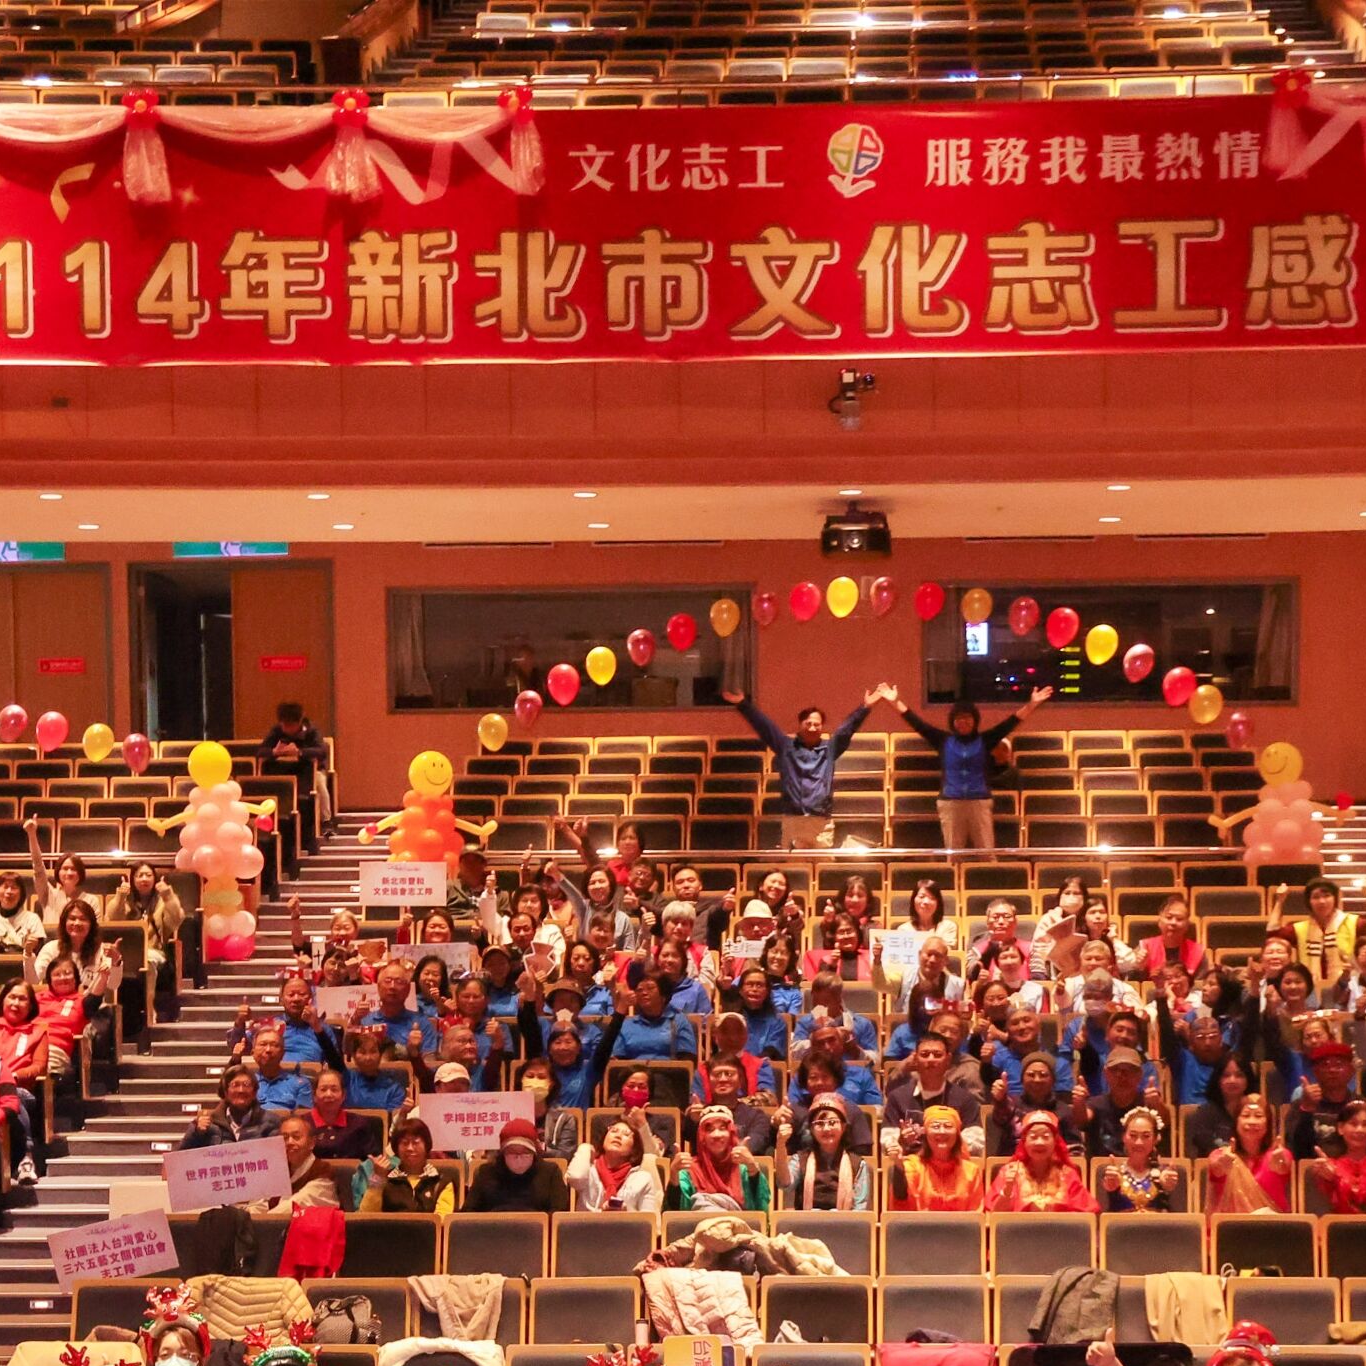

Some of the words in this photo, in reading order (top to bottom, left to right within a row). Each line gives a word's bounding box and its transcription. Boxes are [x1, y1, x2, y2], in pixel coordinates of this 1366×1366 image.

[567, 143, 785, 191] 文化志工
[925, 130, 1263, 187] 服務我最熱情
[460, 1125, 494, 1137] 志工隊
[185, 1158, 270, 1182] 世界宗教博物館
[211, 1176, 247, 1192] 志工隊
[64, 1229, 158, 1261] 社團法人台灣愛心
